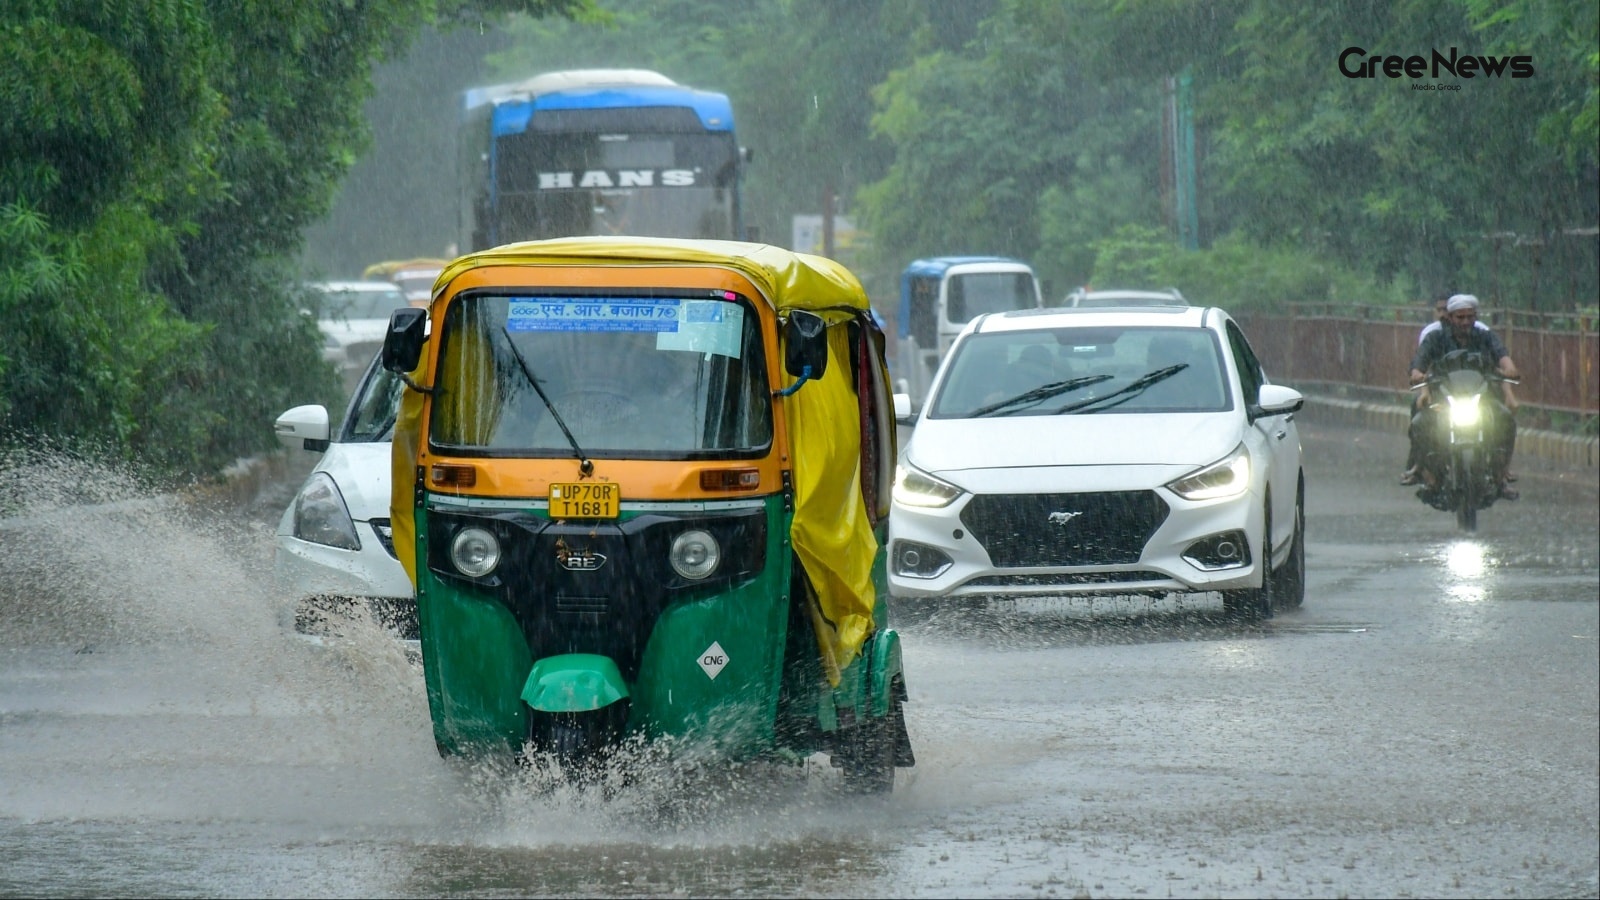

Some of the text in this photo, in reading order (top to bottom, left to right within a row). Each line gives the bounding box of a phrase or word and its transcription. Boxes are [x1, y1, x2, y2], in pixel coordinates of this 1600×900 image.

[538, 169, 696, 189] HANS
[540, 304, 570, 317] एस.
[574, 304, 606, 317] आर.
[609, 305, 655, 317] बजाज
[562, 485, 611, 500] UP70R
[562, 501, 609, 516] T1681
[567, 557, 596, 568] RE
[703, 655, 723, 666] CNG
